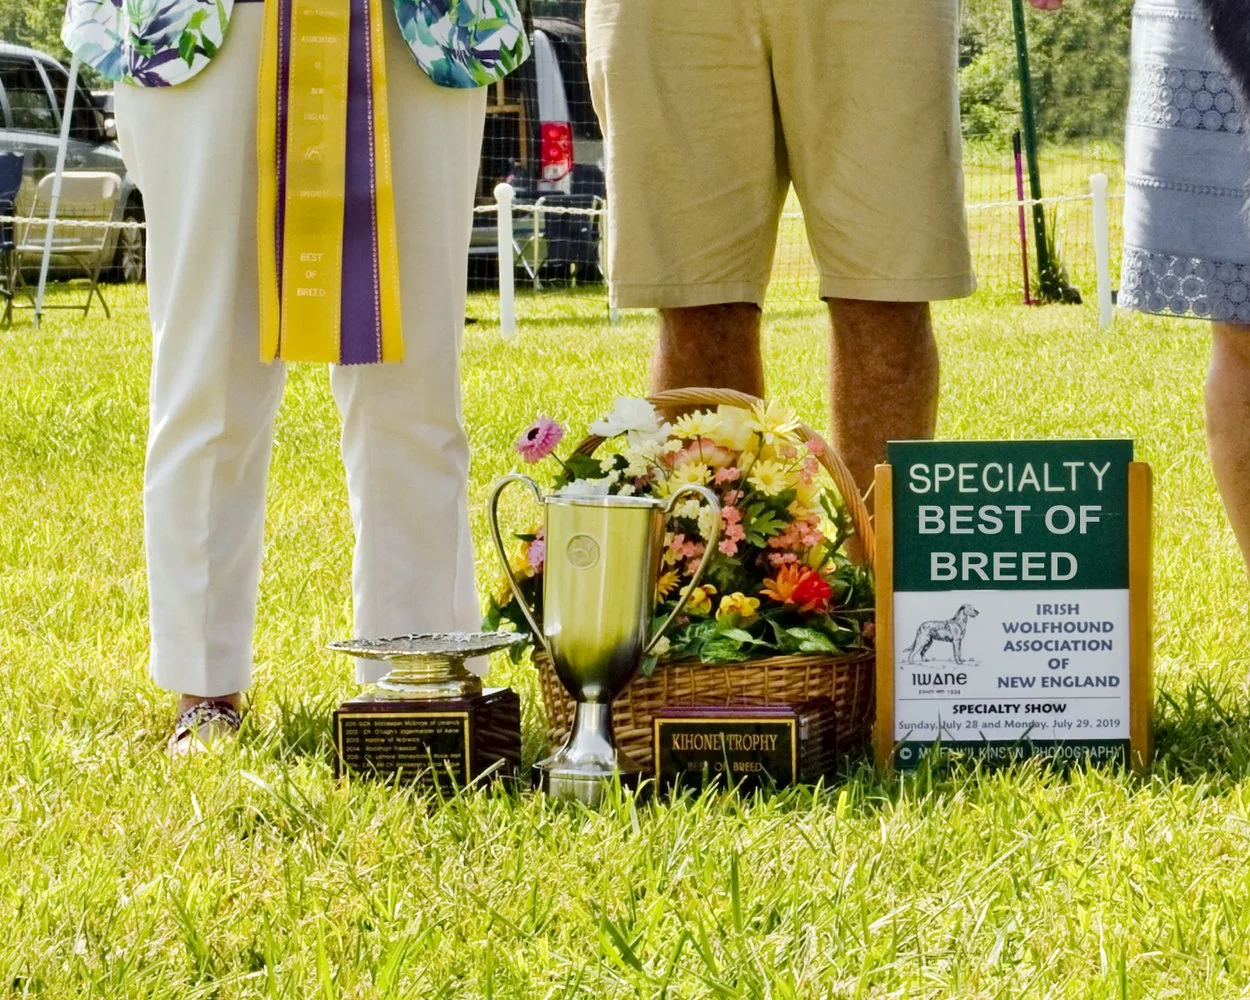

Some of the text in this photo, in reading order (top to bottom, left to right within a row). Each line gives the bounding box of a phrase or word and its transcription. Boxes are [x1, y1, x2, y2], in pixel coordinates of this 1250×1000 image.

[909, 461, 1112, 494] SPECIALTY
[918, 504, 1102, 535] BEST OF
[930, 551, 1079, 582] BREED
[1036, 603, 1080, 616] IRISH
[1002, 621, 1114, 634] WOLFHOUND
[1003, 639, 1113, 652] ASSOCIATION
[1047, 657, 1070, 670] OF
[997, 675, 1121, 689] NEW ENGLAND
[952, 703, 1067, 715] SPECIALTY SHOW
[941, 720, 962, 731] July
[965, 720, 979, 729] 28
[982, 719, 1002, 729] and
[1051, 718, 1074, 730] July
[1096, 718, 1121, 728] 2019
[671, 733, 778, 751] KIHONE TROPHY
[732, 760, 763, 773] BREED
